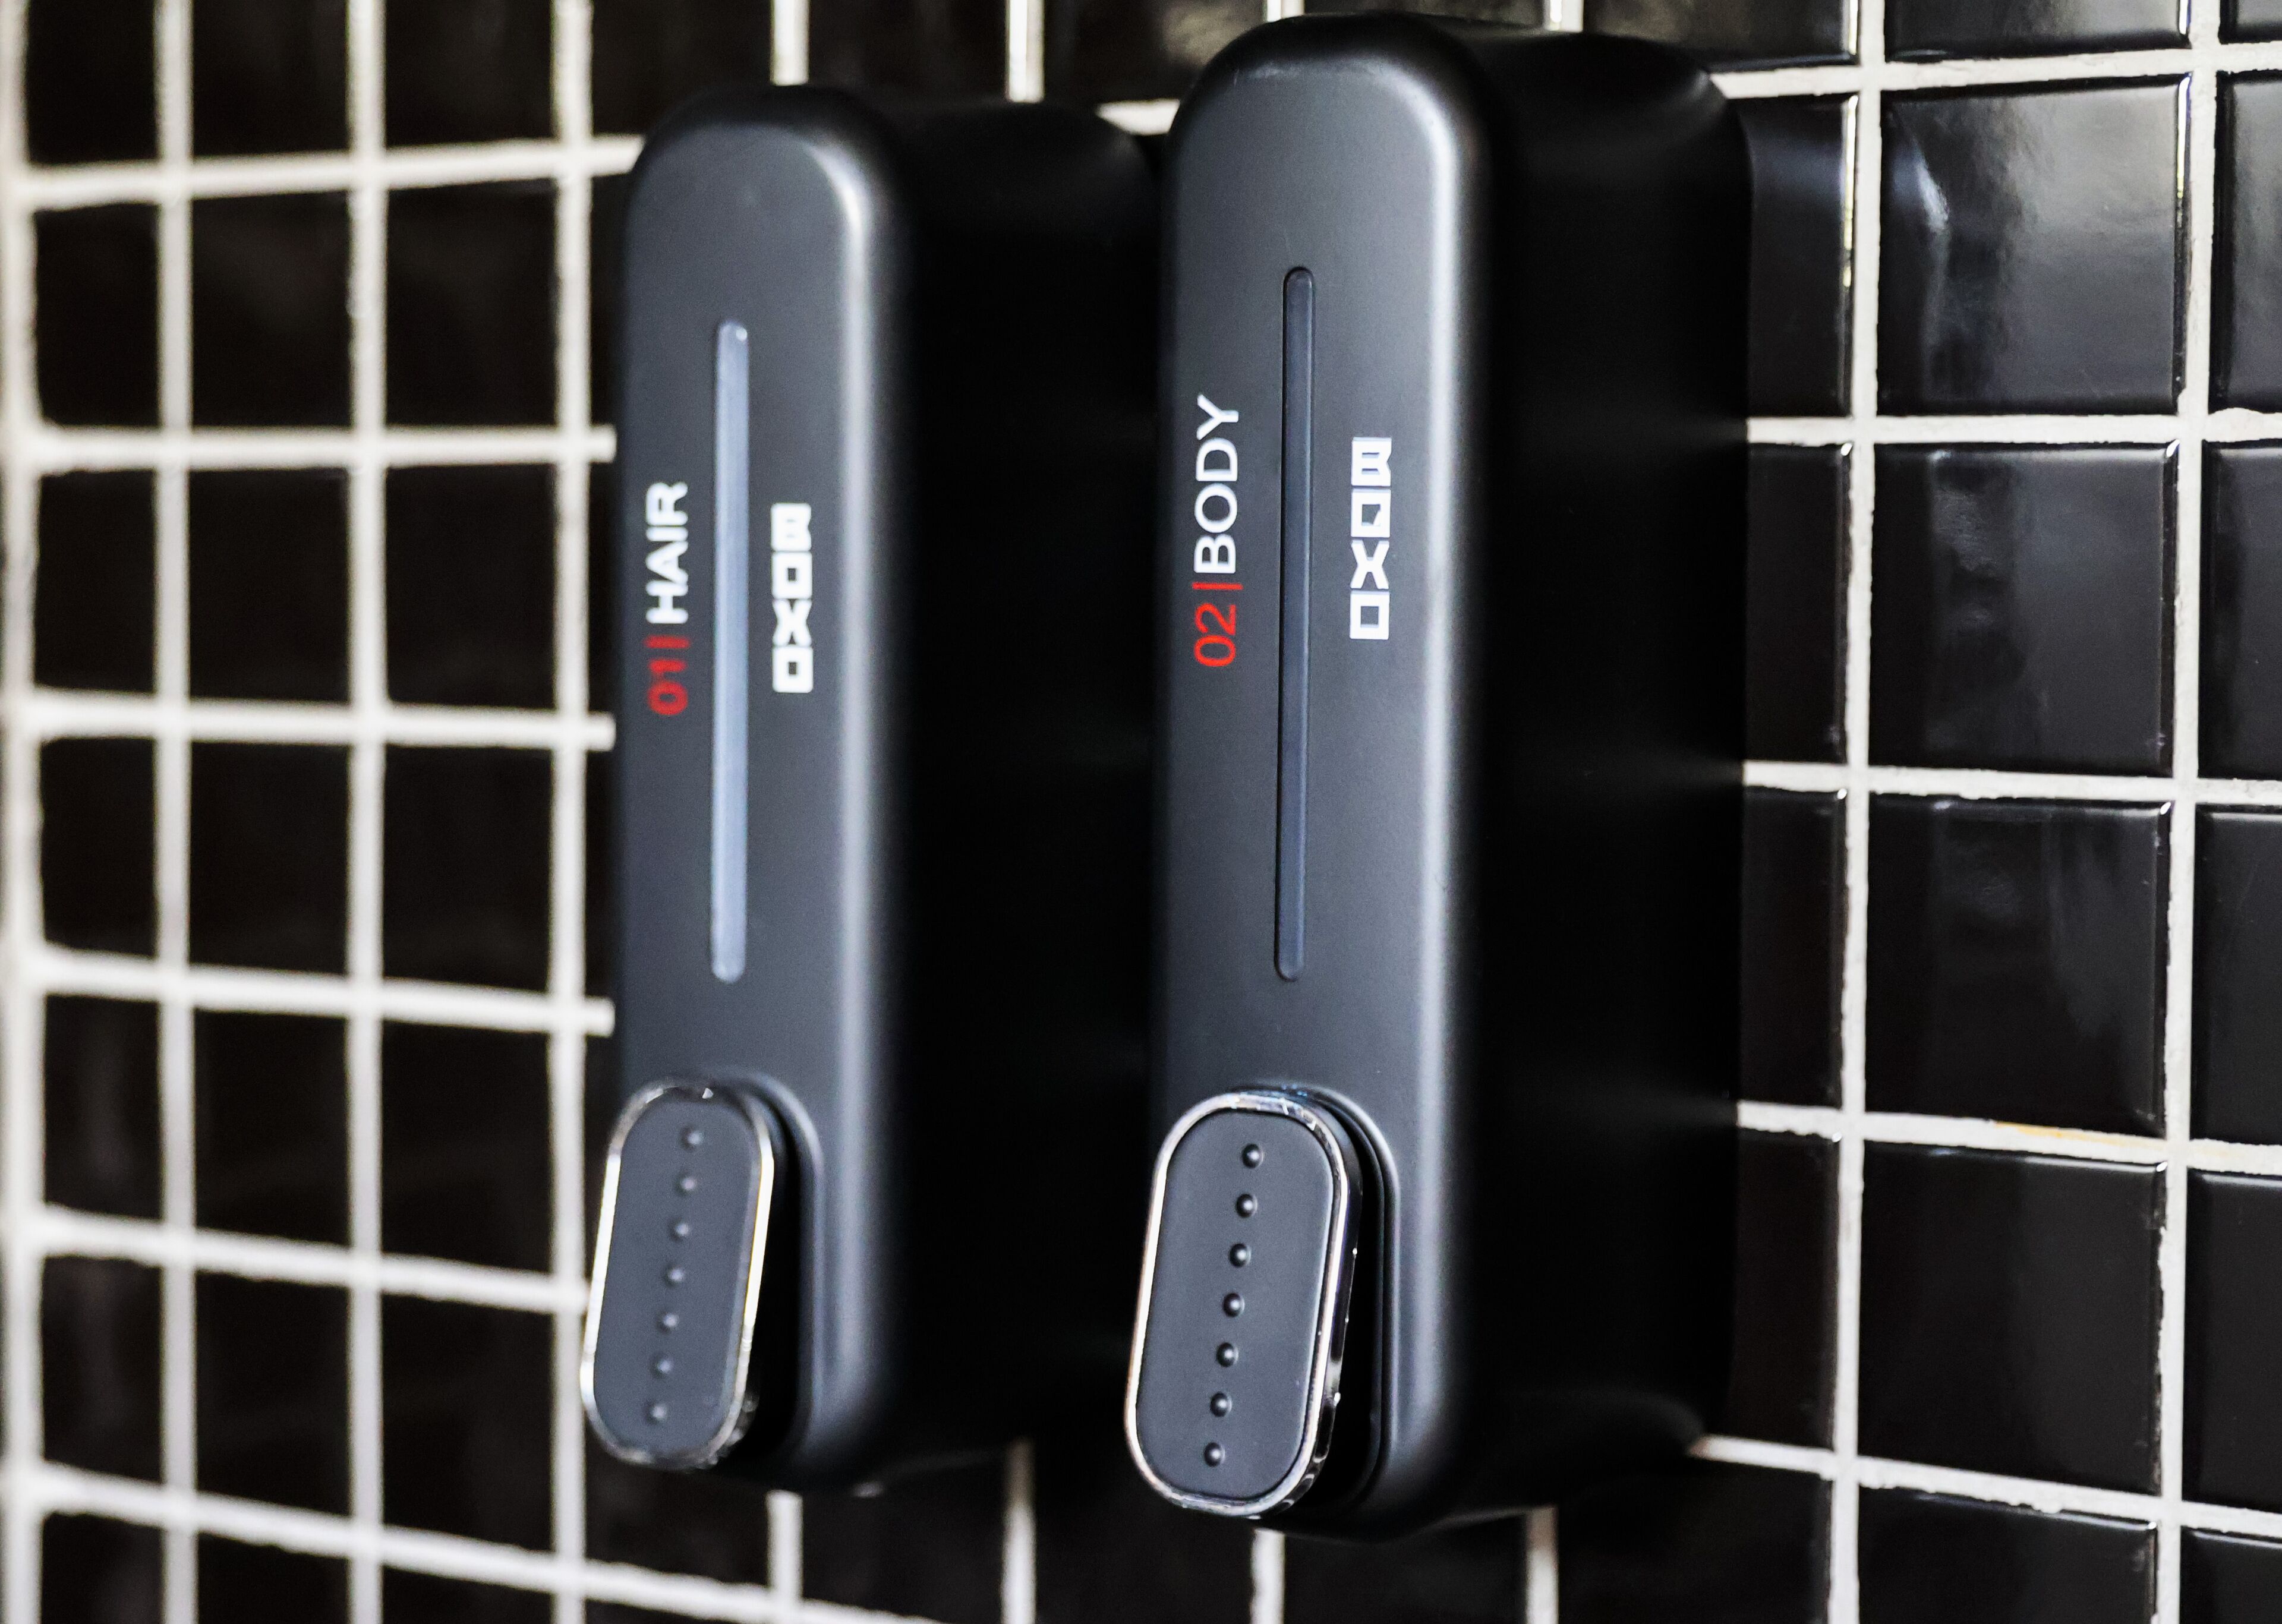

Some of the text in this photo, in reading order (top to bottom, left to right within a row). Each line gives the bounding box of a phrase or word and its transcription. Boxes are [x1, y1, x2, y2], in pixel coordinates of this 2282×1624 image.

[645, 482, 689, 625] HAIR
[1193, 393, 1240, 574] BODY
[770, 503, 814, 693] BOXO
[1192, 603, 1238, 667] 02
[645, 658, 689, 715] 01
